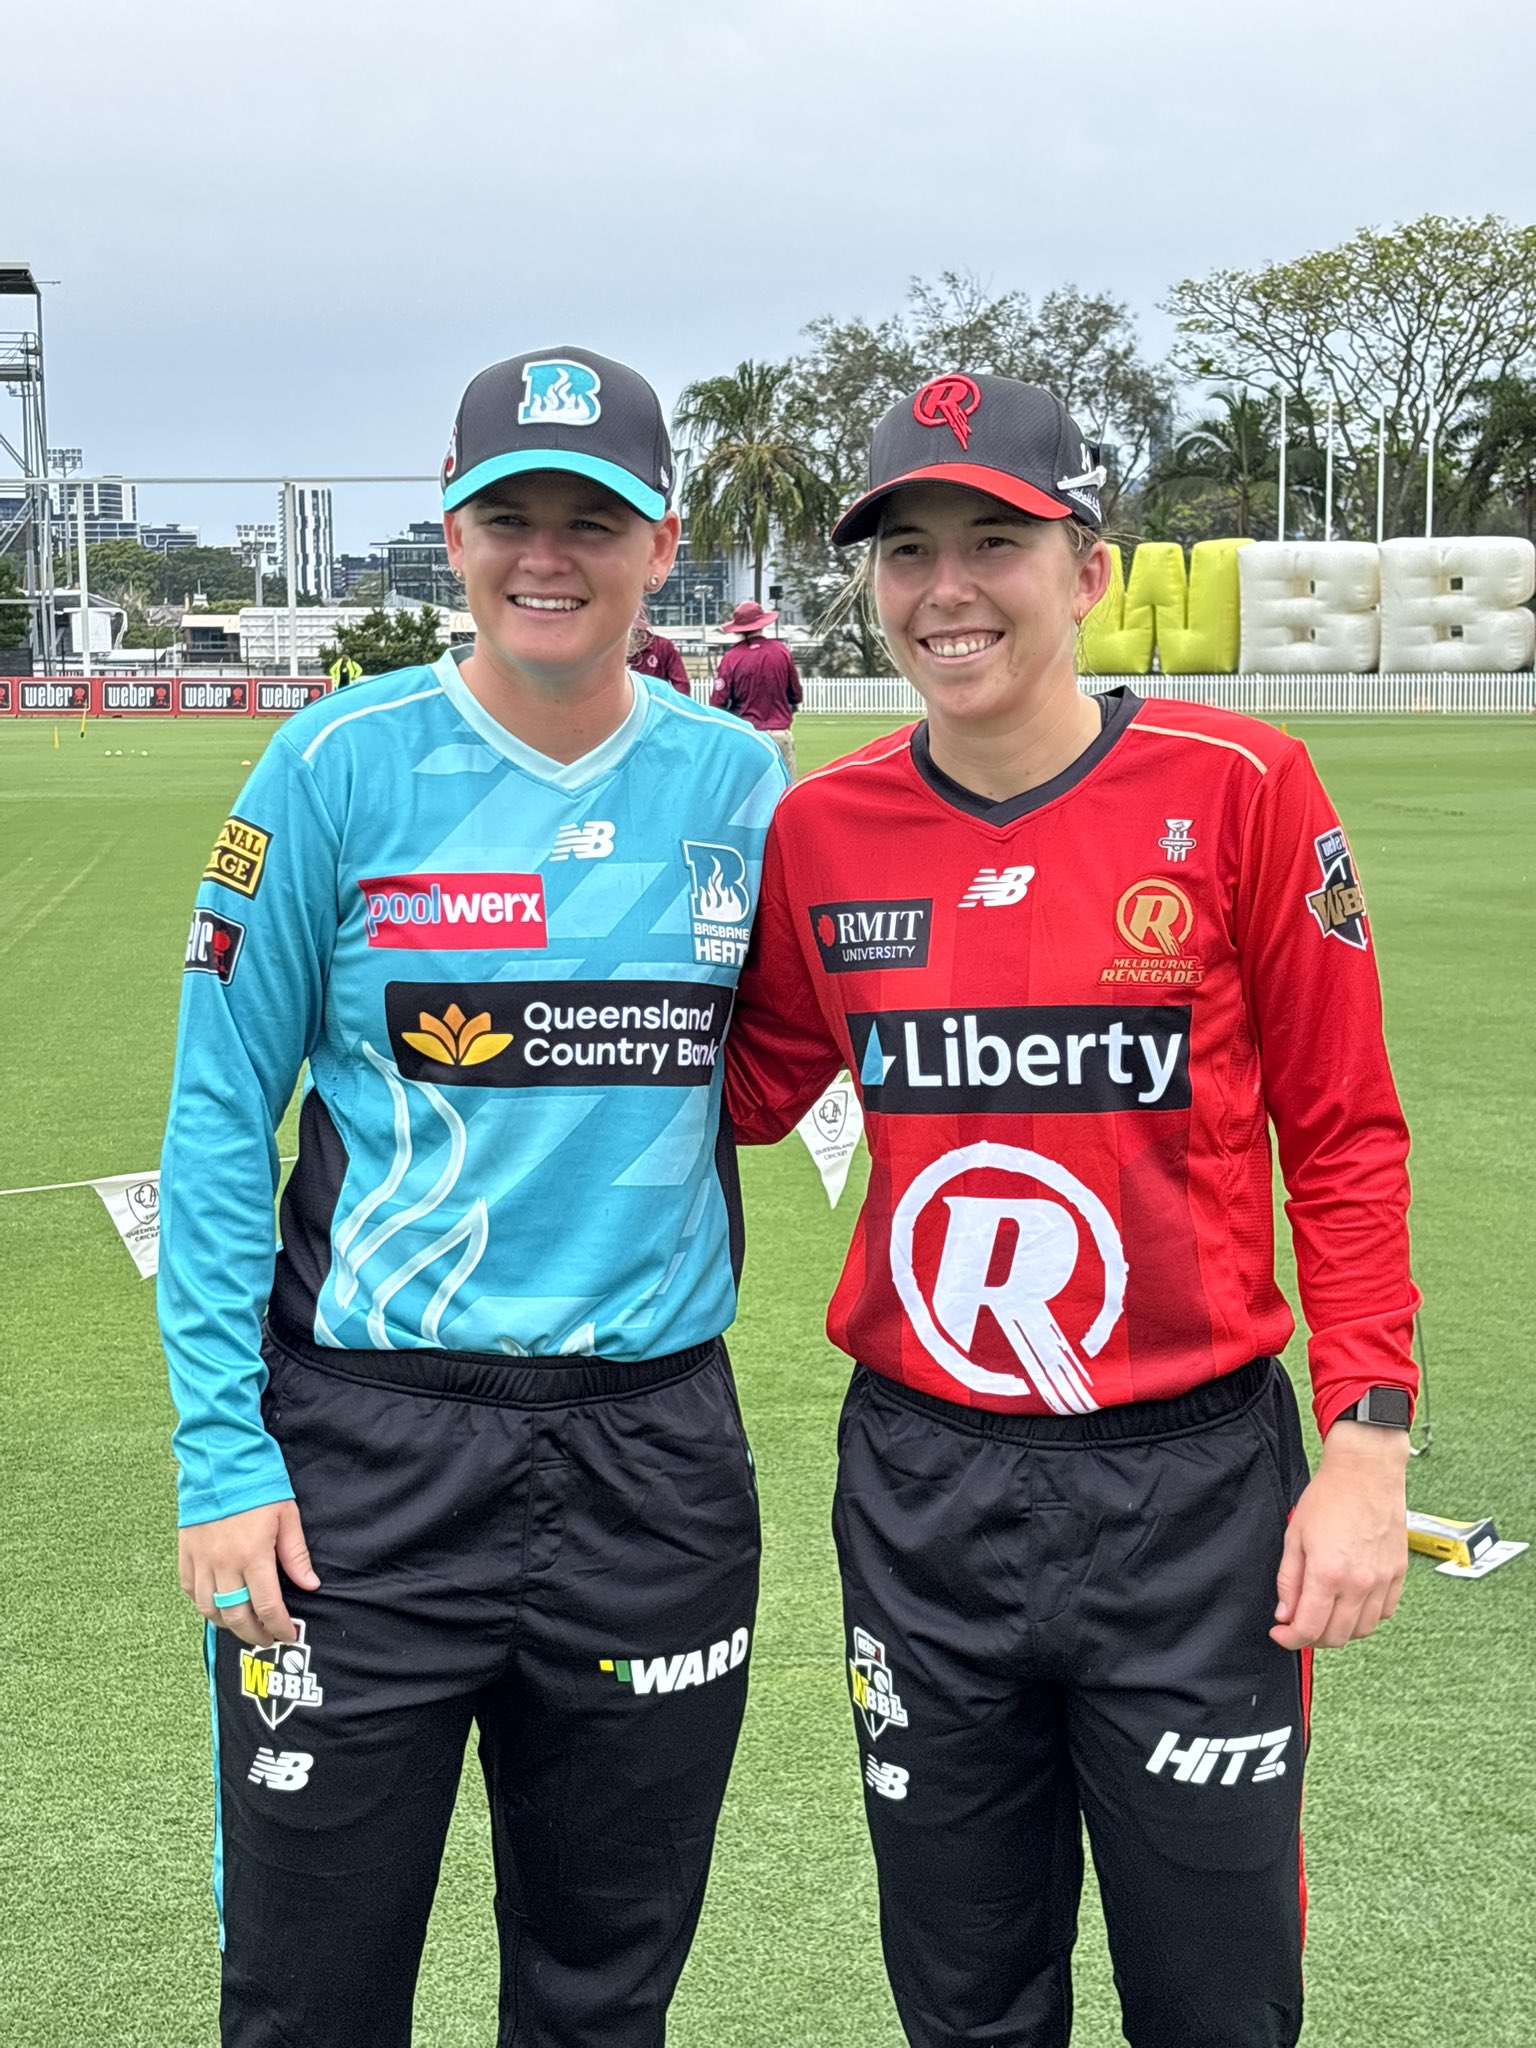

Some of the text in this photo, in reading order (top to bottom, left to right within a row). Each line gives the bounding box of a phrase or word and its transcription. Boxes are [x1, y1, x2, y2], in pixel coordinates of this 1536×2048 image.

[24, 683, 73, 707] weber
[108, 683, 155, 707] weber
[185, 683, 231, 708] weber
[262, 684, 309, 708] weber
[368, 883, 543, 938] poolwerx
[693, 922, 750, 940] BRISBANE
[837, 911, 924, 944] RMIT
[694, 938, 748, 966] HEAT
[842, 945, 916, 962] UNIVERSITY
[1112, 958, 1197, 970] MELBOURNE
[1100, 969, 1204, 984] RENEGADES
[524, 999, 715, 1033] Queensland
[524, 1037, 719, 1075] Country Bank
[904, 1015, 1183, 1103] Liberty
[630, 1627, 749, 1695] WARD
[243, 1654, 320, 1703] WBBL
[850, 1664, 906, 1722] WBBL
